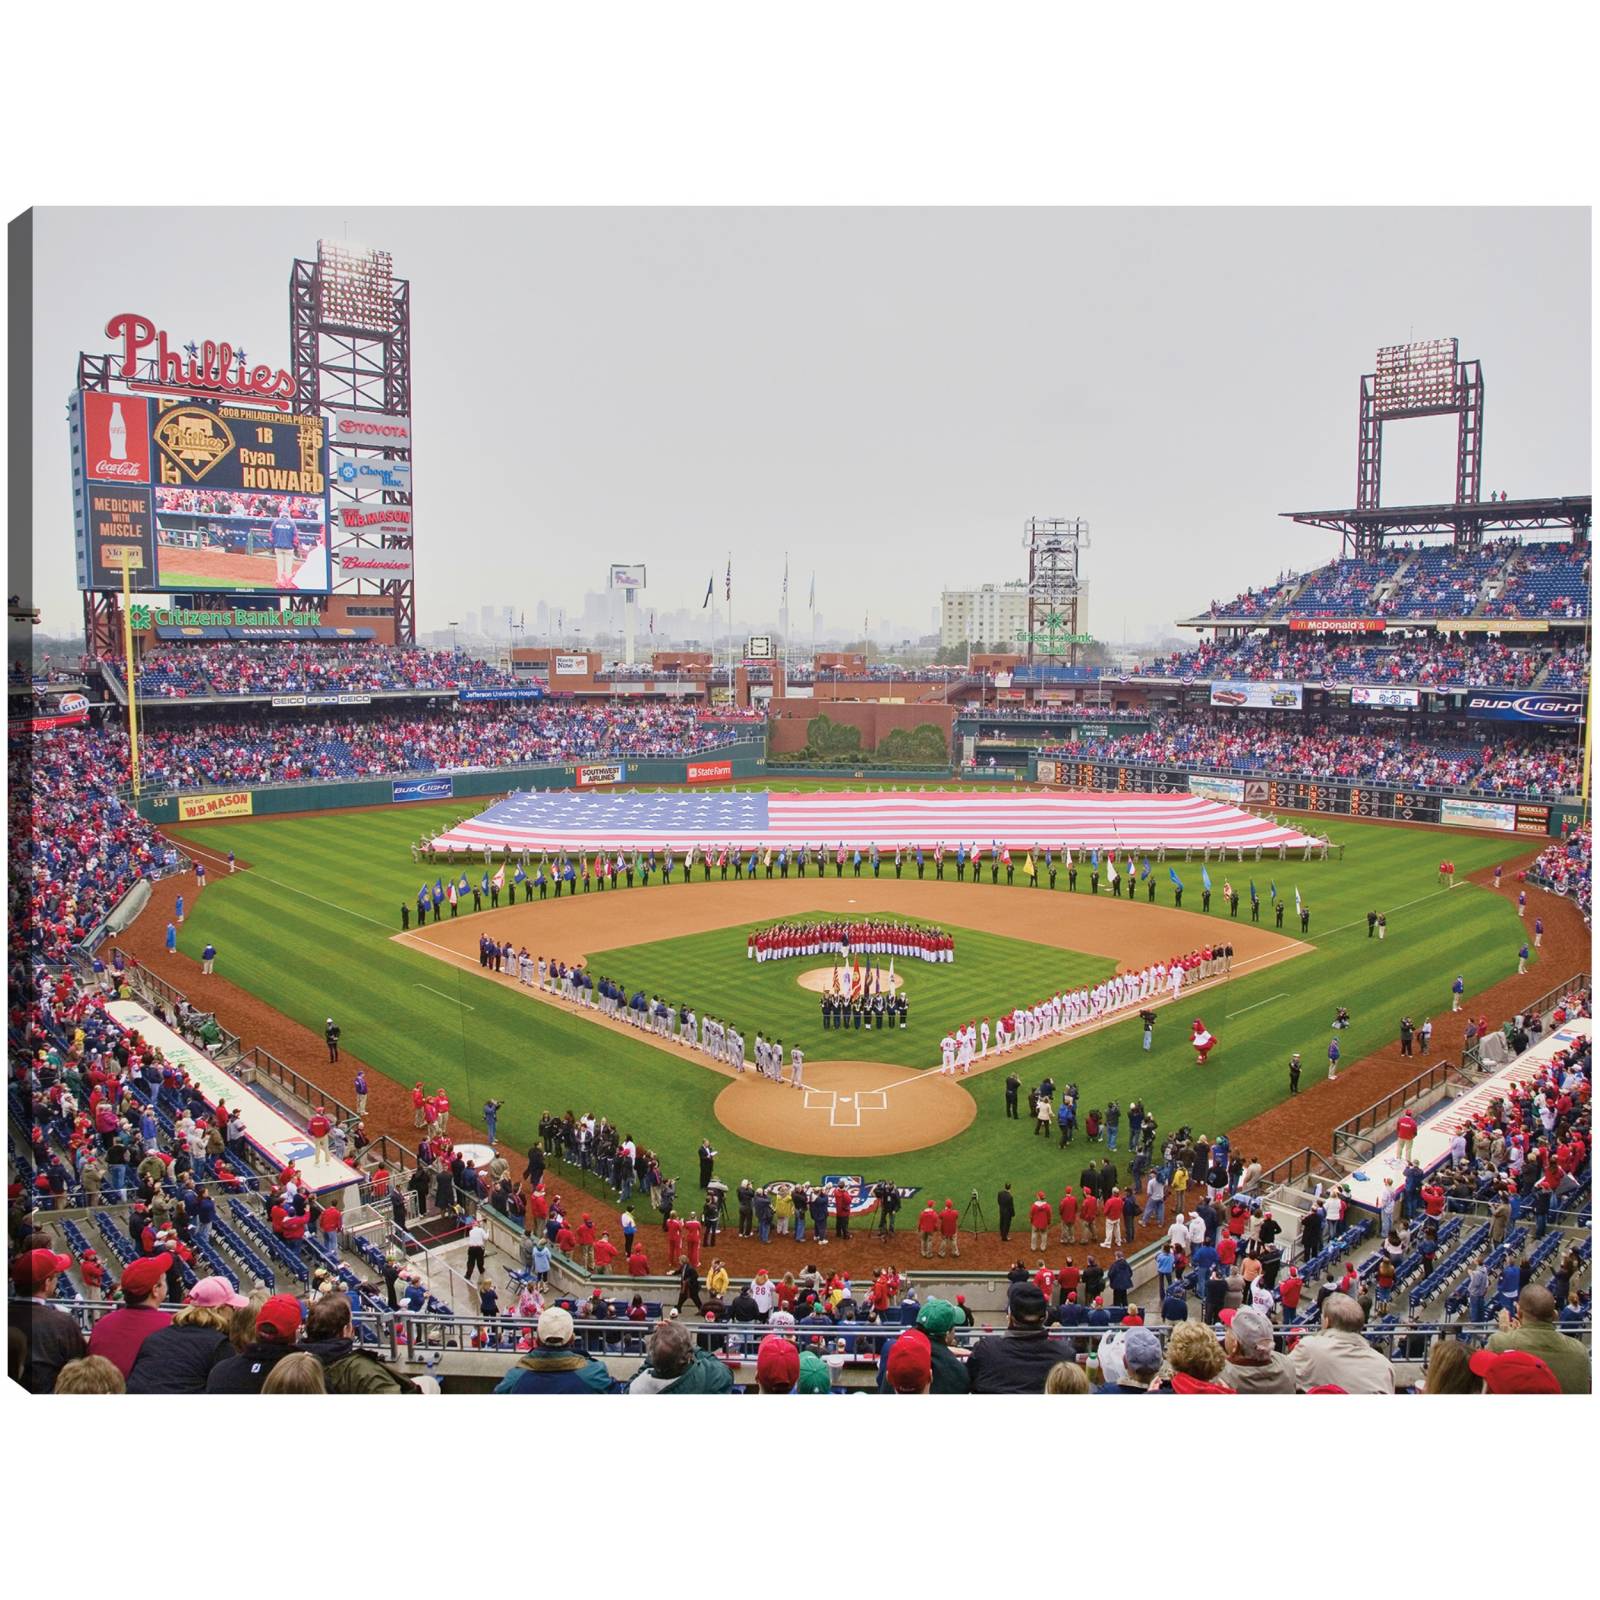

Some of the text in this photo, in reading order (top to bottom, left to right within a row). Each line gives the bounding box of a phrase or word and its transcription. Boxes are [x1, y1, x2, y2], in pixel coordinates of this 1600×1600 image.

[105, 313, 297, 399] Phillies
[219, 407, 239, 418] 2008
[240, 409, 292, 423] PHILADELPHIA
[256, 427, 273, 444] 1B
[355, 422, 408, 438] TOYOTA
[163, 424, 225, 452] Phillies
[297, 428, 323, 449] #6
[240, 448, 275, 466] Ryan
[96, 460, 141, 476] Coca-Cola
[360, 465, 393, 476] Choose
[243, 467, 324, 493] HOWARD
[94, 497, 146, 513] MEDICINE
[112, 512, 130, 523] WITH
[100, 523, 143, 537] MUSCLE
[342, 556, 410, 570] Budweiser
[155, 608, 321, 626] Citizens Bank Park
[1308, 621, 1365, 631] McDonald's
[340, 695, 370, 703] GEICO
[493, 690, 518, 698] University
[62, 699, 86, 712] Gulf
[1469, 698, 1583, 712] BUD LIGHT
[582, 767, 619, 776] SOUTHWEST
[588, 773, 615, 781] AIRLINES
[394, 786, 416, 794] BUD
